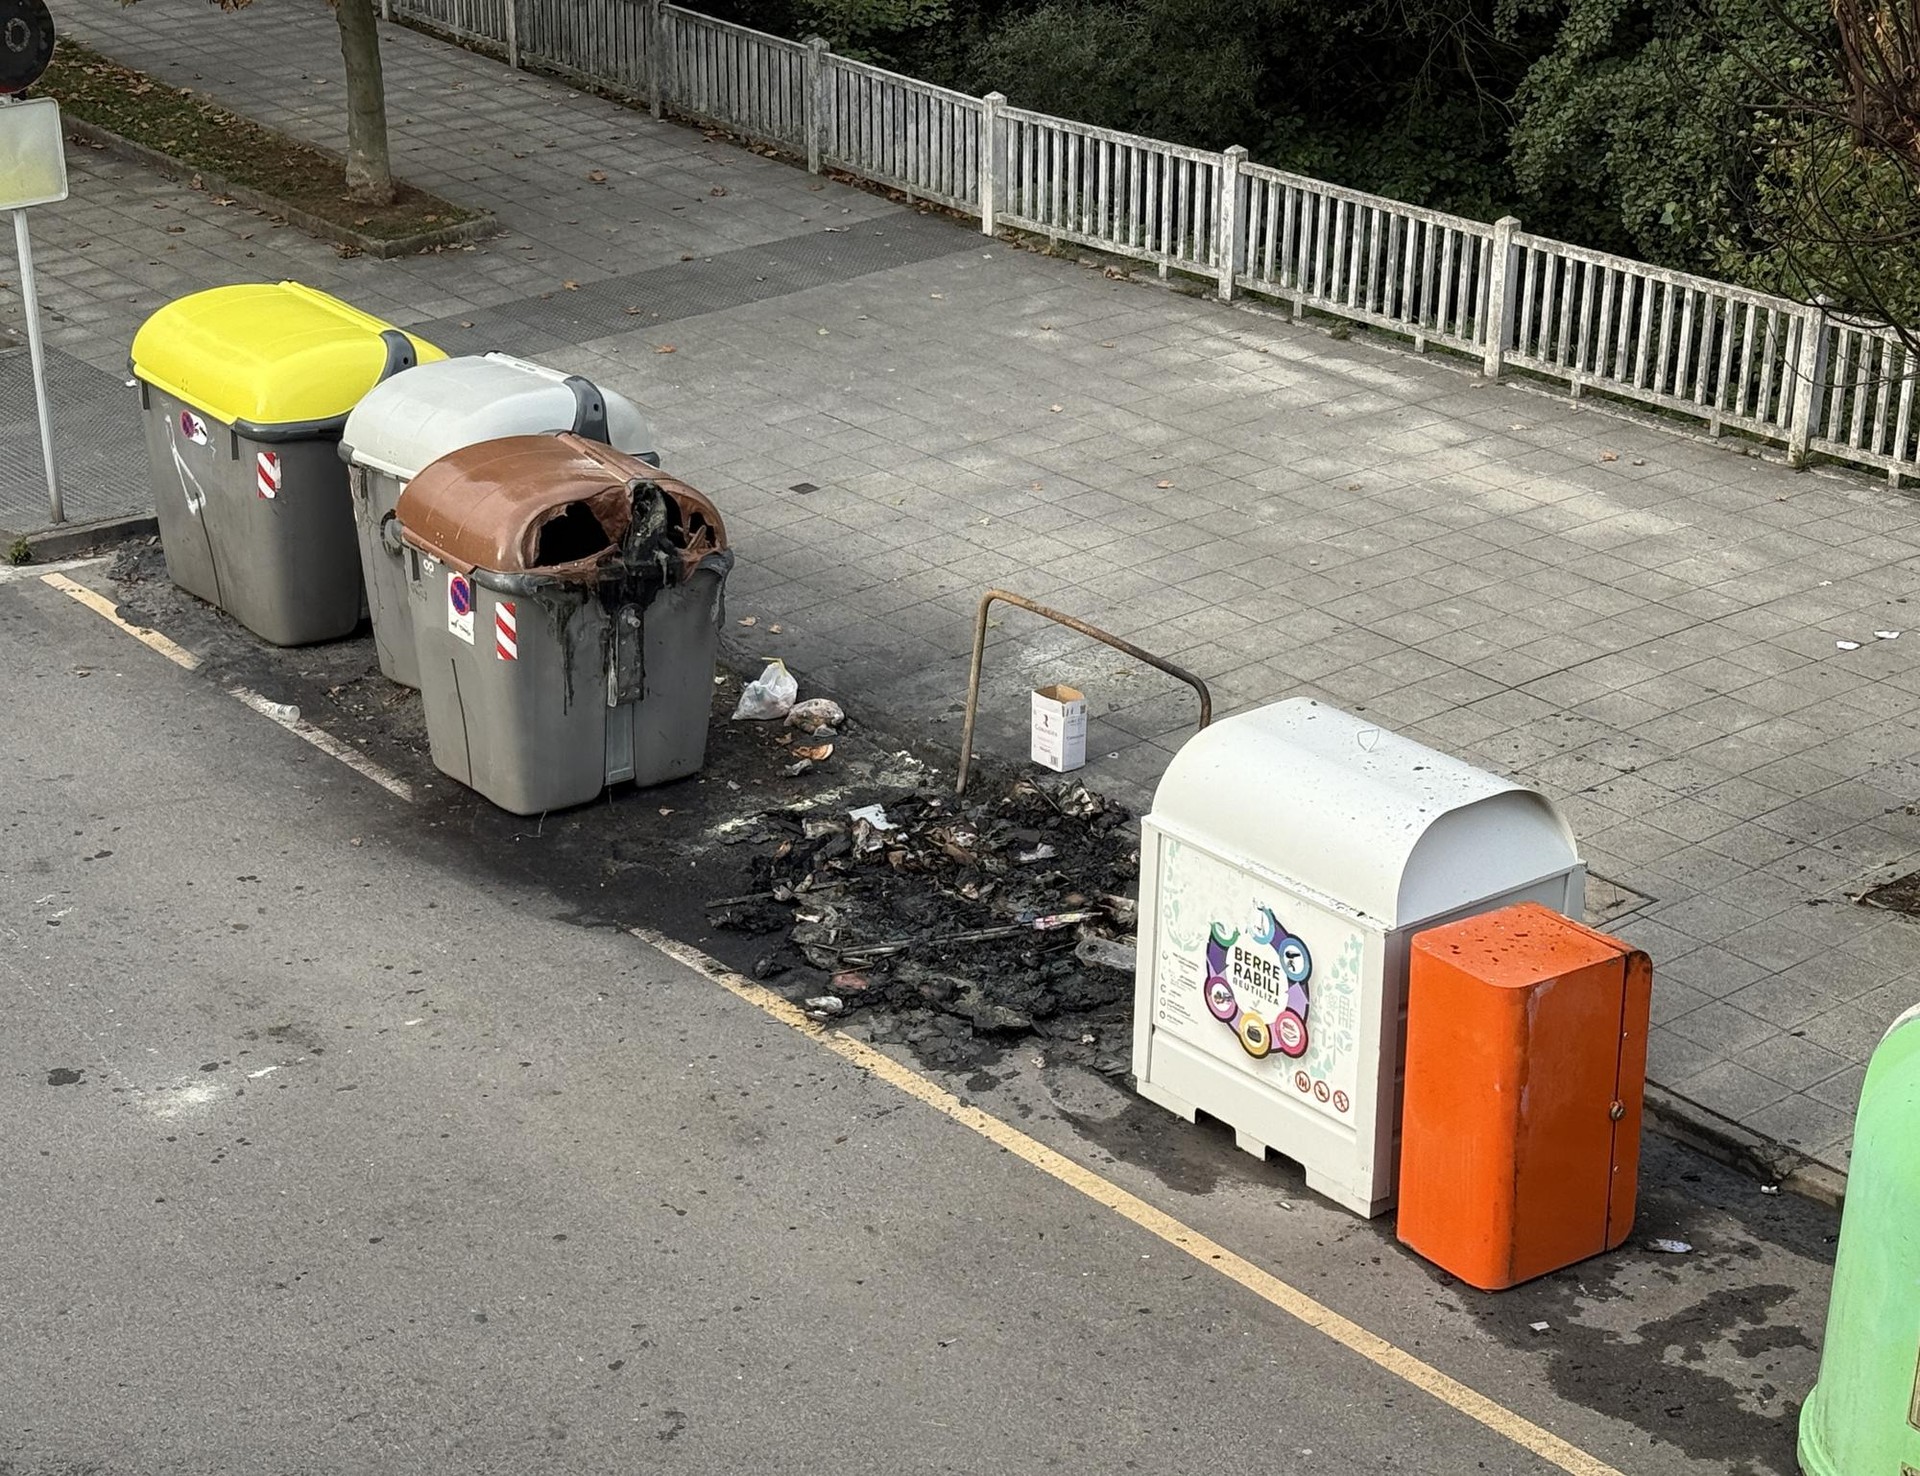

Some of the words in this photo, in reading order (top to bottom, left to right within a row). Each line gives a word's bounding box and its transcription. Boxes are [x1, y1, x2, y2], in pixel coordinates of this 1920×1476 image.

[1233, 962, 1279, 996] RABILI
[1234, 946, 1280, 981] BERRE
[1232, 977, 1279, 1006] REUTILIZA
